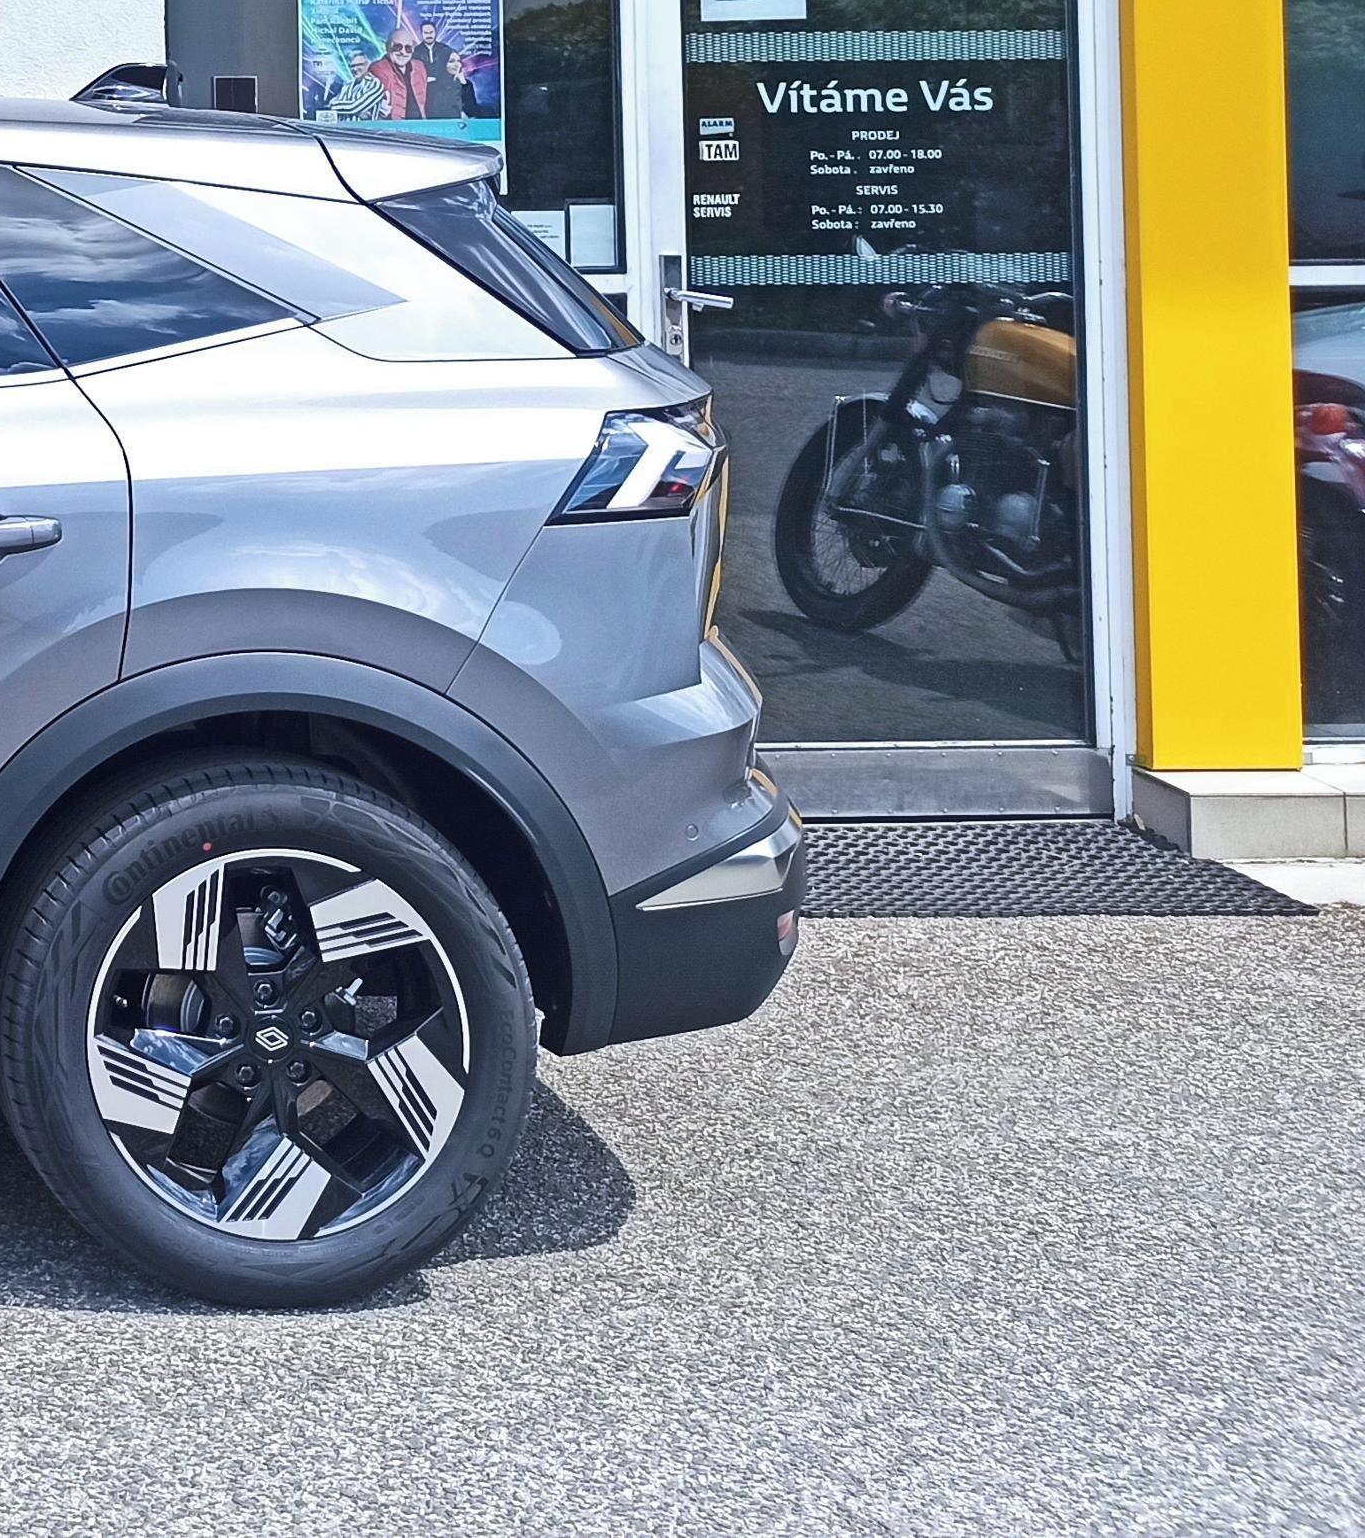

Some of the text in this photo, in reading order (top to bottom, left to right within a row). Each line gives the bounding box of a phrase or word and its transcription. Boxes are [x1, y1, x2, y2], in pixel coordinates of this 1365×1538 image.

[756, 78, 994, 114] Vítáme Vás
[701, 120, 733, 128] ALARM
[851, 130, 900, 141] PRODEJ
[705, 143, 738, 159] TAM
[869, 163, 915, 174] zavřeno
[855, 184, 899, 196] SERVIS
[692, 193, 741, 206] RENAULT
[692, 206, 732, 218] SERVIS
[870, 217, 917, 229] zavřeno
[102, 806, 255, 905] Continental
[491, 1013, 517, 1124] EcoContact
